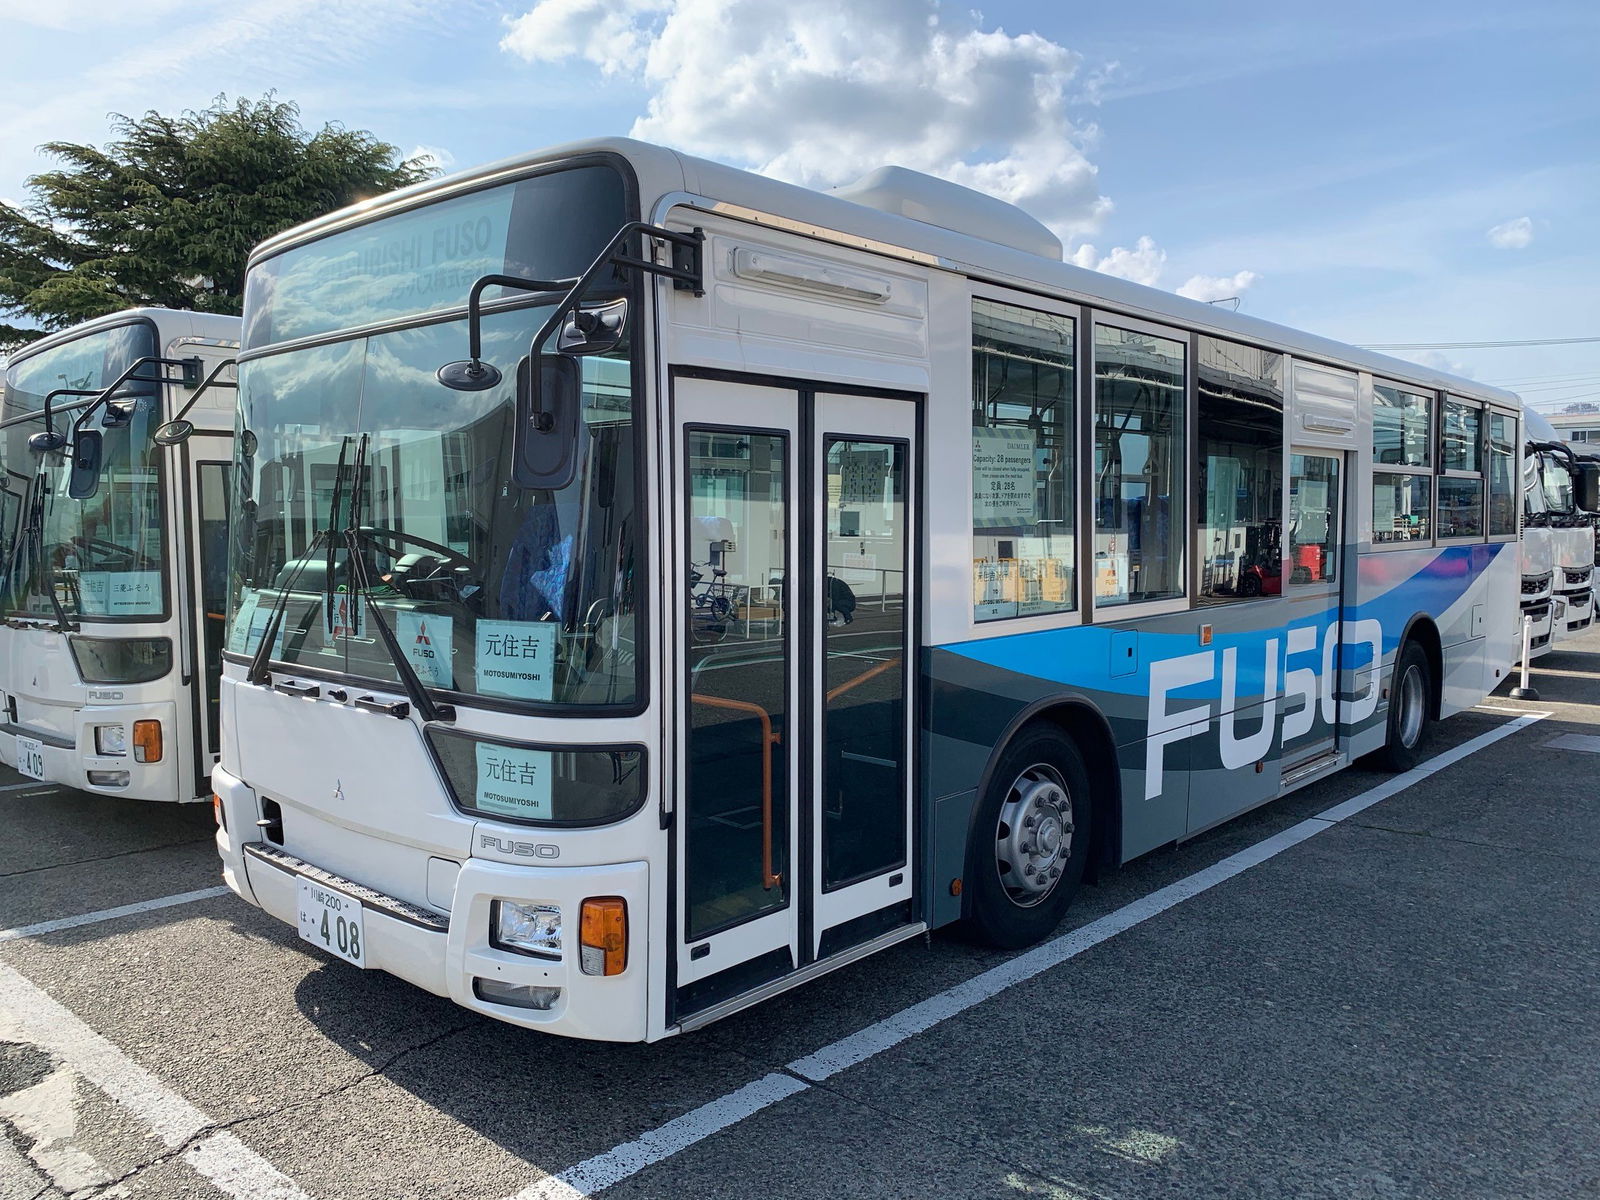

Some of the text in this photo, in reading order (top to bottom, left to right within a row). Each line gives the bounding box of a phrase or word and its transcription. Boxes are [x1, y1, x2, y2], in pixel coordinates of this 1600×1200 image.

[431, 215, 492, 264] FUSO
[973, 454, 1031, 465] Capacity: 28 passengers
[412, 647, 435, 659] FUSO
[485, 634, 540, 660] 元住吉
[411, 663, 439, 677] 菱ふそう
[483, 669, 541, 682] MOTOSUMIYOSHI
[88, 691, 124, 700] FUSO
[1145, 618, 1383, 801] FUSO
[26, 751, 44, 777] 409
[485, 756, 537, 786] 元住吉
[483, 791, 540, 807] MOTOSUMIYOSHI
[480, 834, 561, 859] FUSO
[321, 909, 361, 960] 408
